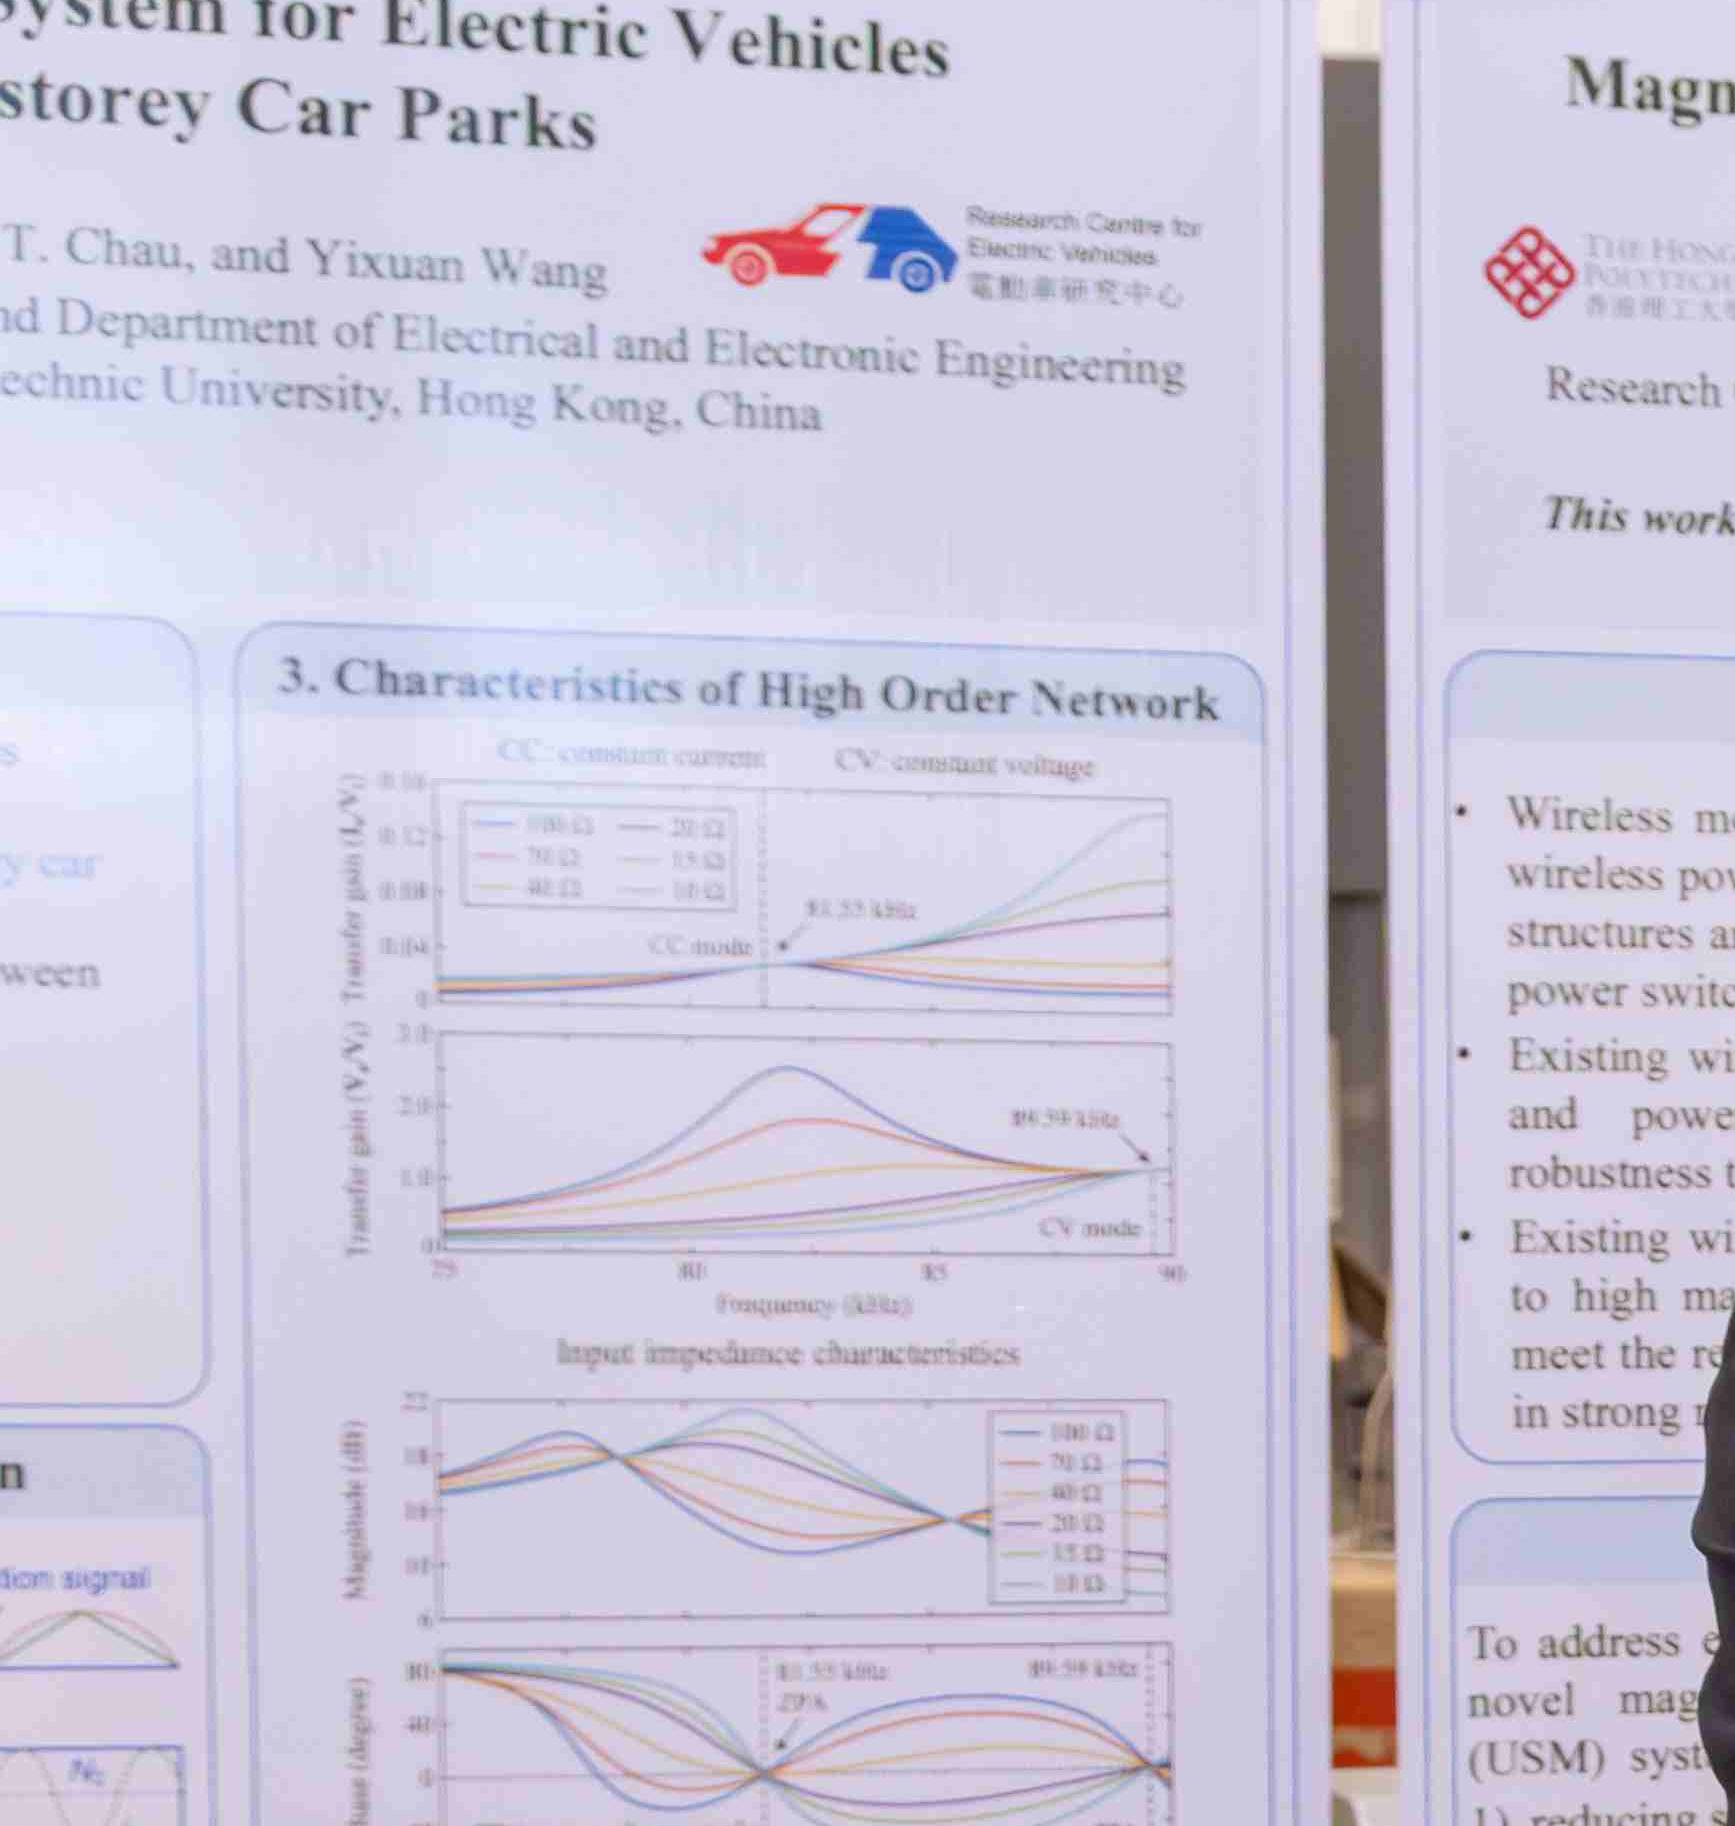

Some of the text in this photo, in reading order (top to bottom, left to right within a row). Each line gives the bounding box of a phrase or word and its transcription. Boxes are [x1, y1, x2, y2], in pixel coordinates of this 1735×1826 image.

[385, 0, 949, 76] Electric Vehicles
[237, 78, 371, 137] Car
[400, 87, 595, 150] Parks
[65, 227, 608, 300] Chau, and Yixuan Wang
[57, 297, 1187, 397] Department of Electrical and Electronic Engineering
[1547, 365, 1722, 408] Research
[1548, 496, 1627, 531] This
[281, 656, 1221, 722] 3. Characteristics of High Order Network
